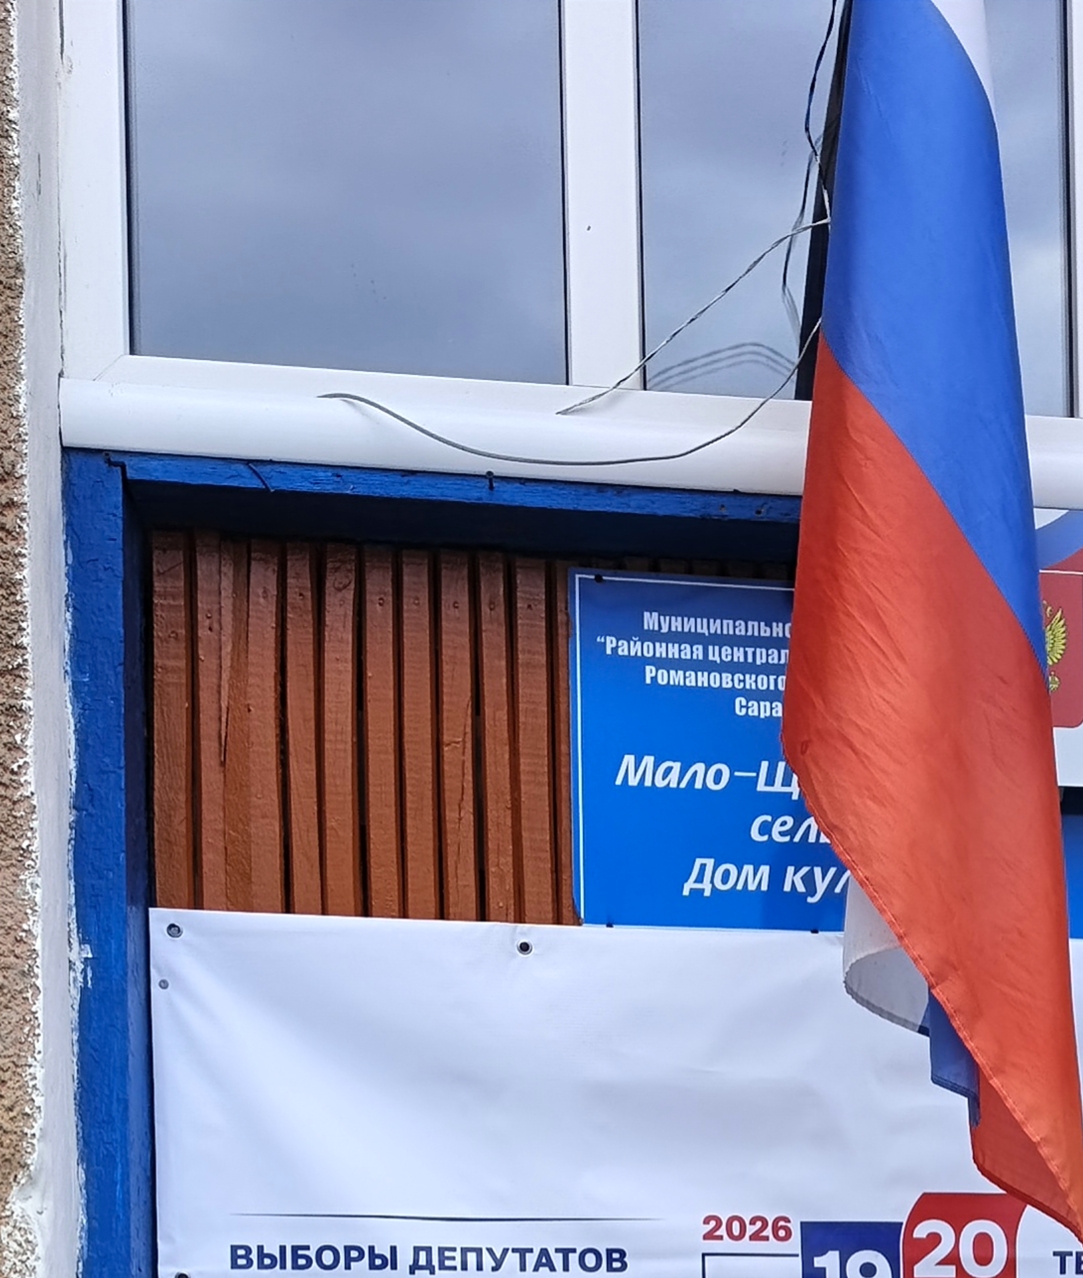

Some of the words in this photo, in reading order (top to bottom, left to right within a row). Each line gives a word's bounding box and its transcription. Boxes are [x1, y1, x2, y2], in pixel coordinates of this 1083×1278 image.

[645, 665, 787, 691] Романовского
[682, 857, 770, 897] Дом
[702, 1215, 793, 1242] 2026
[230, 1244, 398, 1271] ВЫБОРЫ
[409, 1245, 629, 1275] ДЕПУТАТОВ
